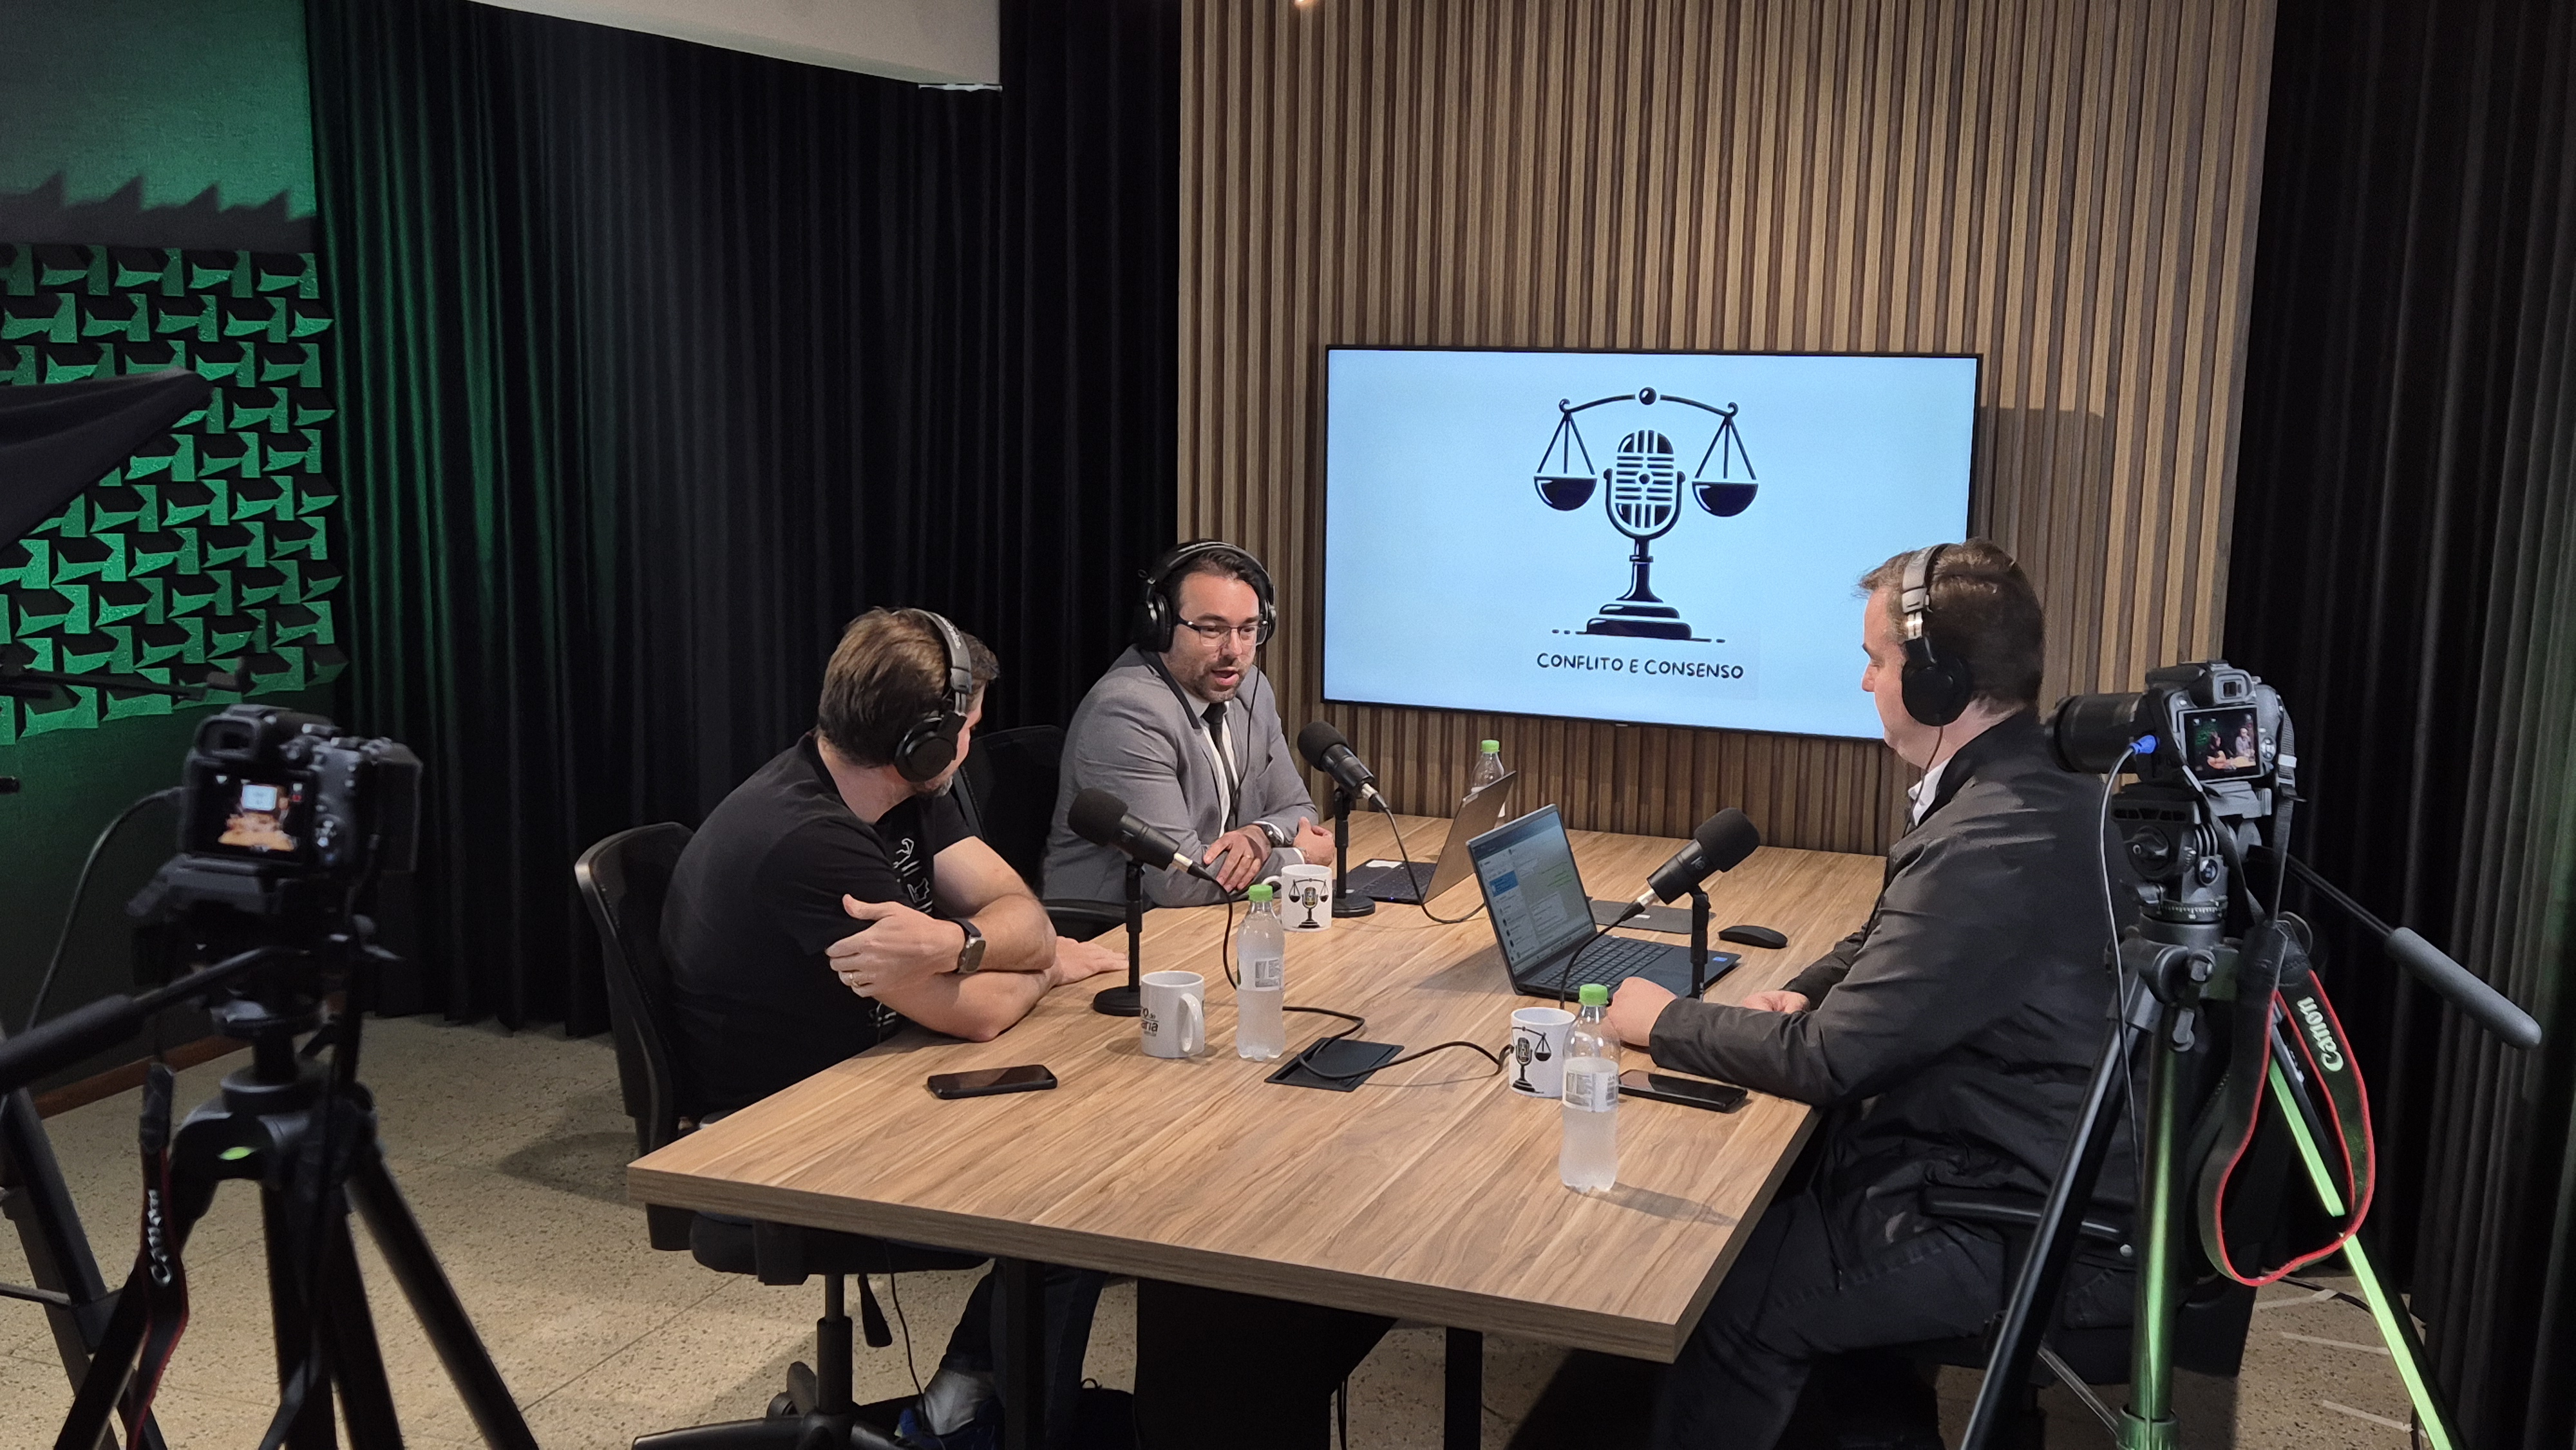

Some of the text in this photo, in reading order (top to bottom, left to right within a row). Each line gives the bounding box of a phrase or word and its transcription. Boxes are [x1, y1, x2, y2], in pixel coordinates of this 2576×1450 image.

[1537, 652, 1744, 679] CONFLITO E CONSENSO
[2297, 996, 2344, 1072] Canon
